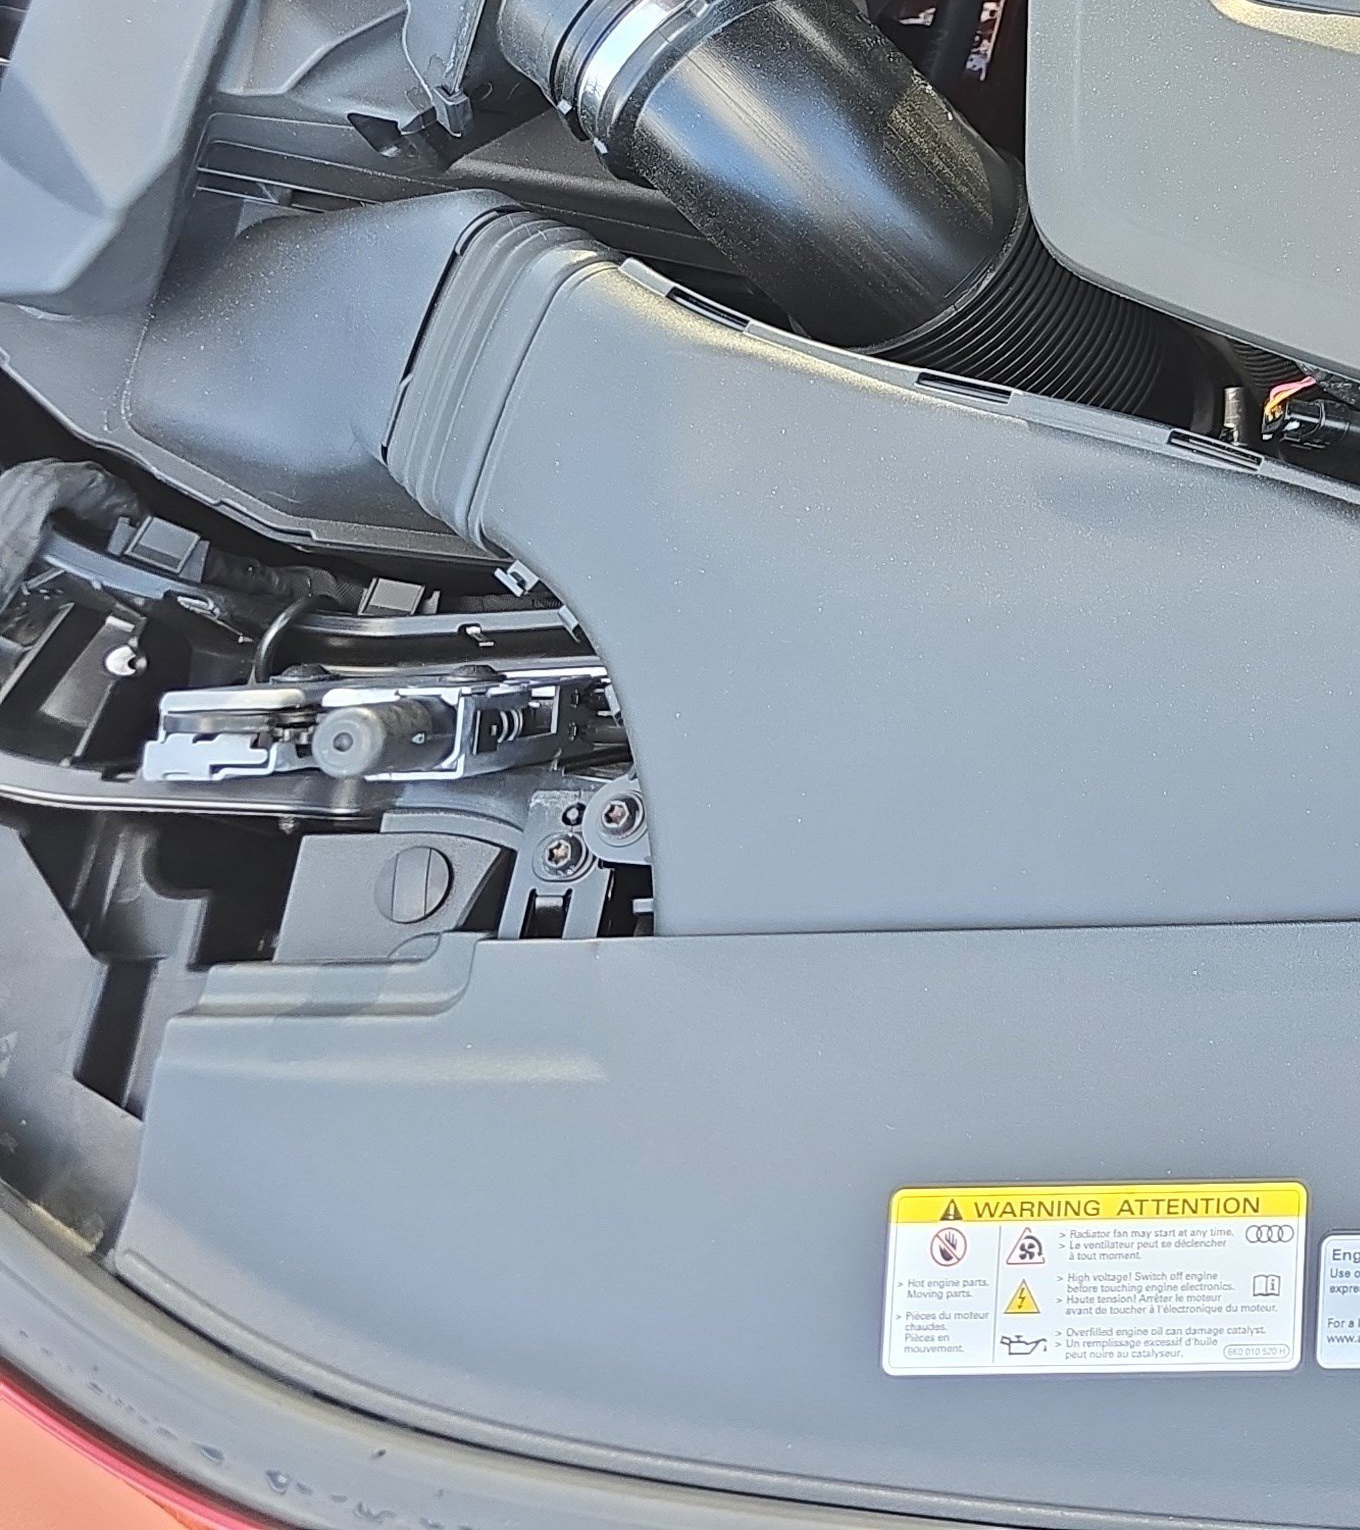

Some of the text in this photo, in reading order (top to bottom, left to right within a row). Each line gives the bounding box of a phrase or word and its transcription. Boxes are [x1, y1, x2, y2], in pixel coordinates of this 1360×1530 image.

[974, 1197, 1260, 1218] WARNING ATTENTION
[1070, 1230, 1110, 1238] Radiator
[1114, 1229, 1127, 1237] fan
[1131, 1230, 1151, 1239] may
[1190, 1230, 1207, 1238] any
[1210, 1227, 1234, 1236] time.
[1070, 1241, 1080, 1249] Le
[1083, 1240, 1134, 1249] ventilateur
[1137, 1240, 1158, 1250] peut
[1174, 1239, 1227, 1248] déclencher
[1077, 1252, 1096, 1260] tout
[1068, 1272, 1218, 1284] High voltage! Switch off engine
[1330, 1268, 1350, 1278] Use
[907, 1279, 989, 1290] Hot engine parts.
[1067, 1282, 1235, 1293] before touching engine electronics.
[907, 1290, 943, 1300] Moving
[1066, 1295, 1094, 1304] Haute
[1097, 1294, 1136, 1303] tension!
[1138, 1293, 1172, 1303] Arrêter
[1187, 1294, 1221, 1302] moteur
[1066, 1307, 1092, 1315] avant
[1095, 1306, 1107, 1314] de
[1110, 1305, 1146, 1314] toucher
[1226, 1304, 1238, 1313] du
[1241, 1304, 1277, 1312] moteur.
[939, 1311, 950, 1320] du
[954, 1311, 989, 1319] moteur
[1327, 1318, 1345, 1328] For
[1066, 1327, 1113, 1336] Overfilled
[1116, 1328, 1148, 1337] engine
[1151, 1326, 1163, 1335] oil
[1185, 1326, 1224, 1337] damage
[1066, 1339, 1079, 1347] Un
[1082, 1338, 1141, 1349] remplissage
[1144, 1337, 1182, 1347] excessif
[904, 1345, 964, 1353] mouvement.
[1065, 1350, 1086, 1360] peut
[1089, 1350, 1113, 1358] nuire
